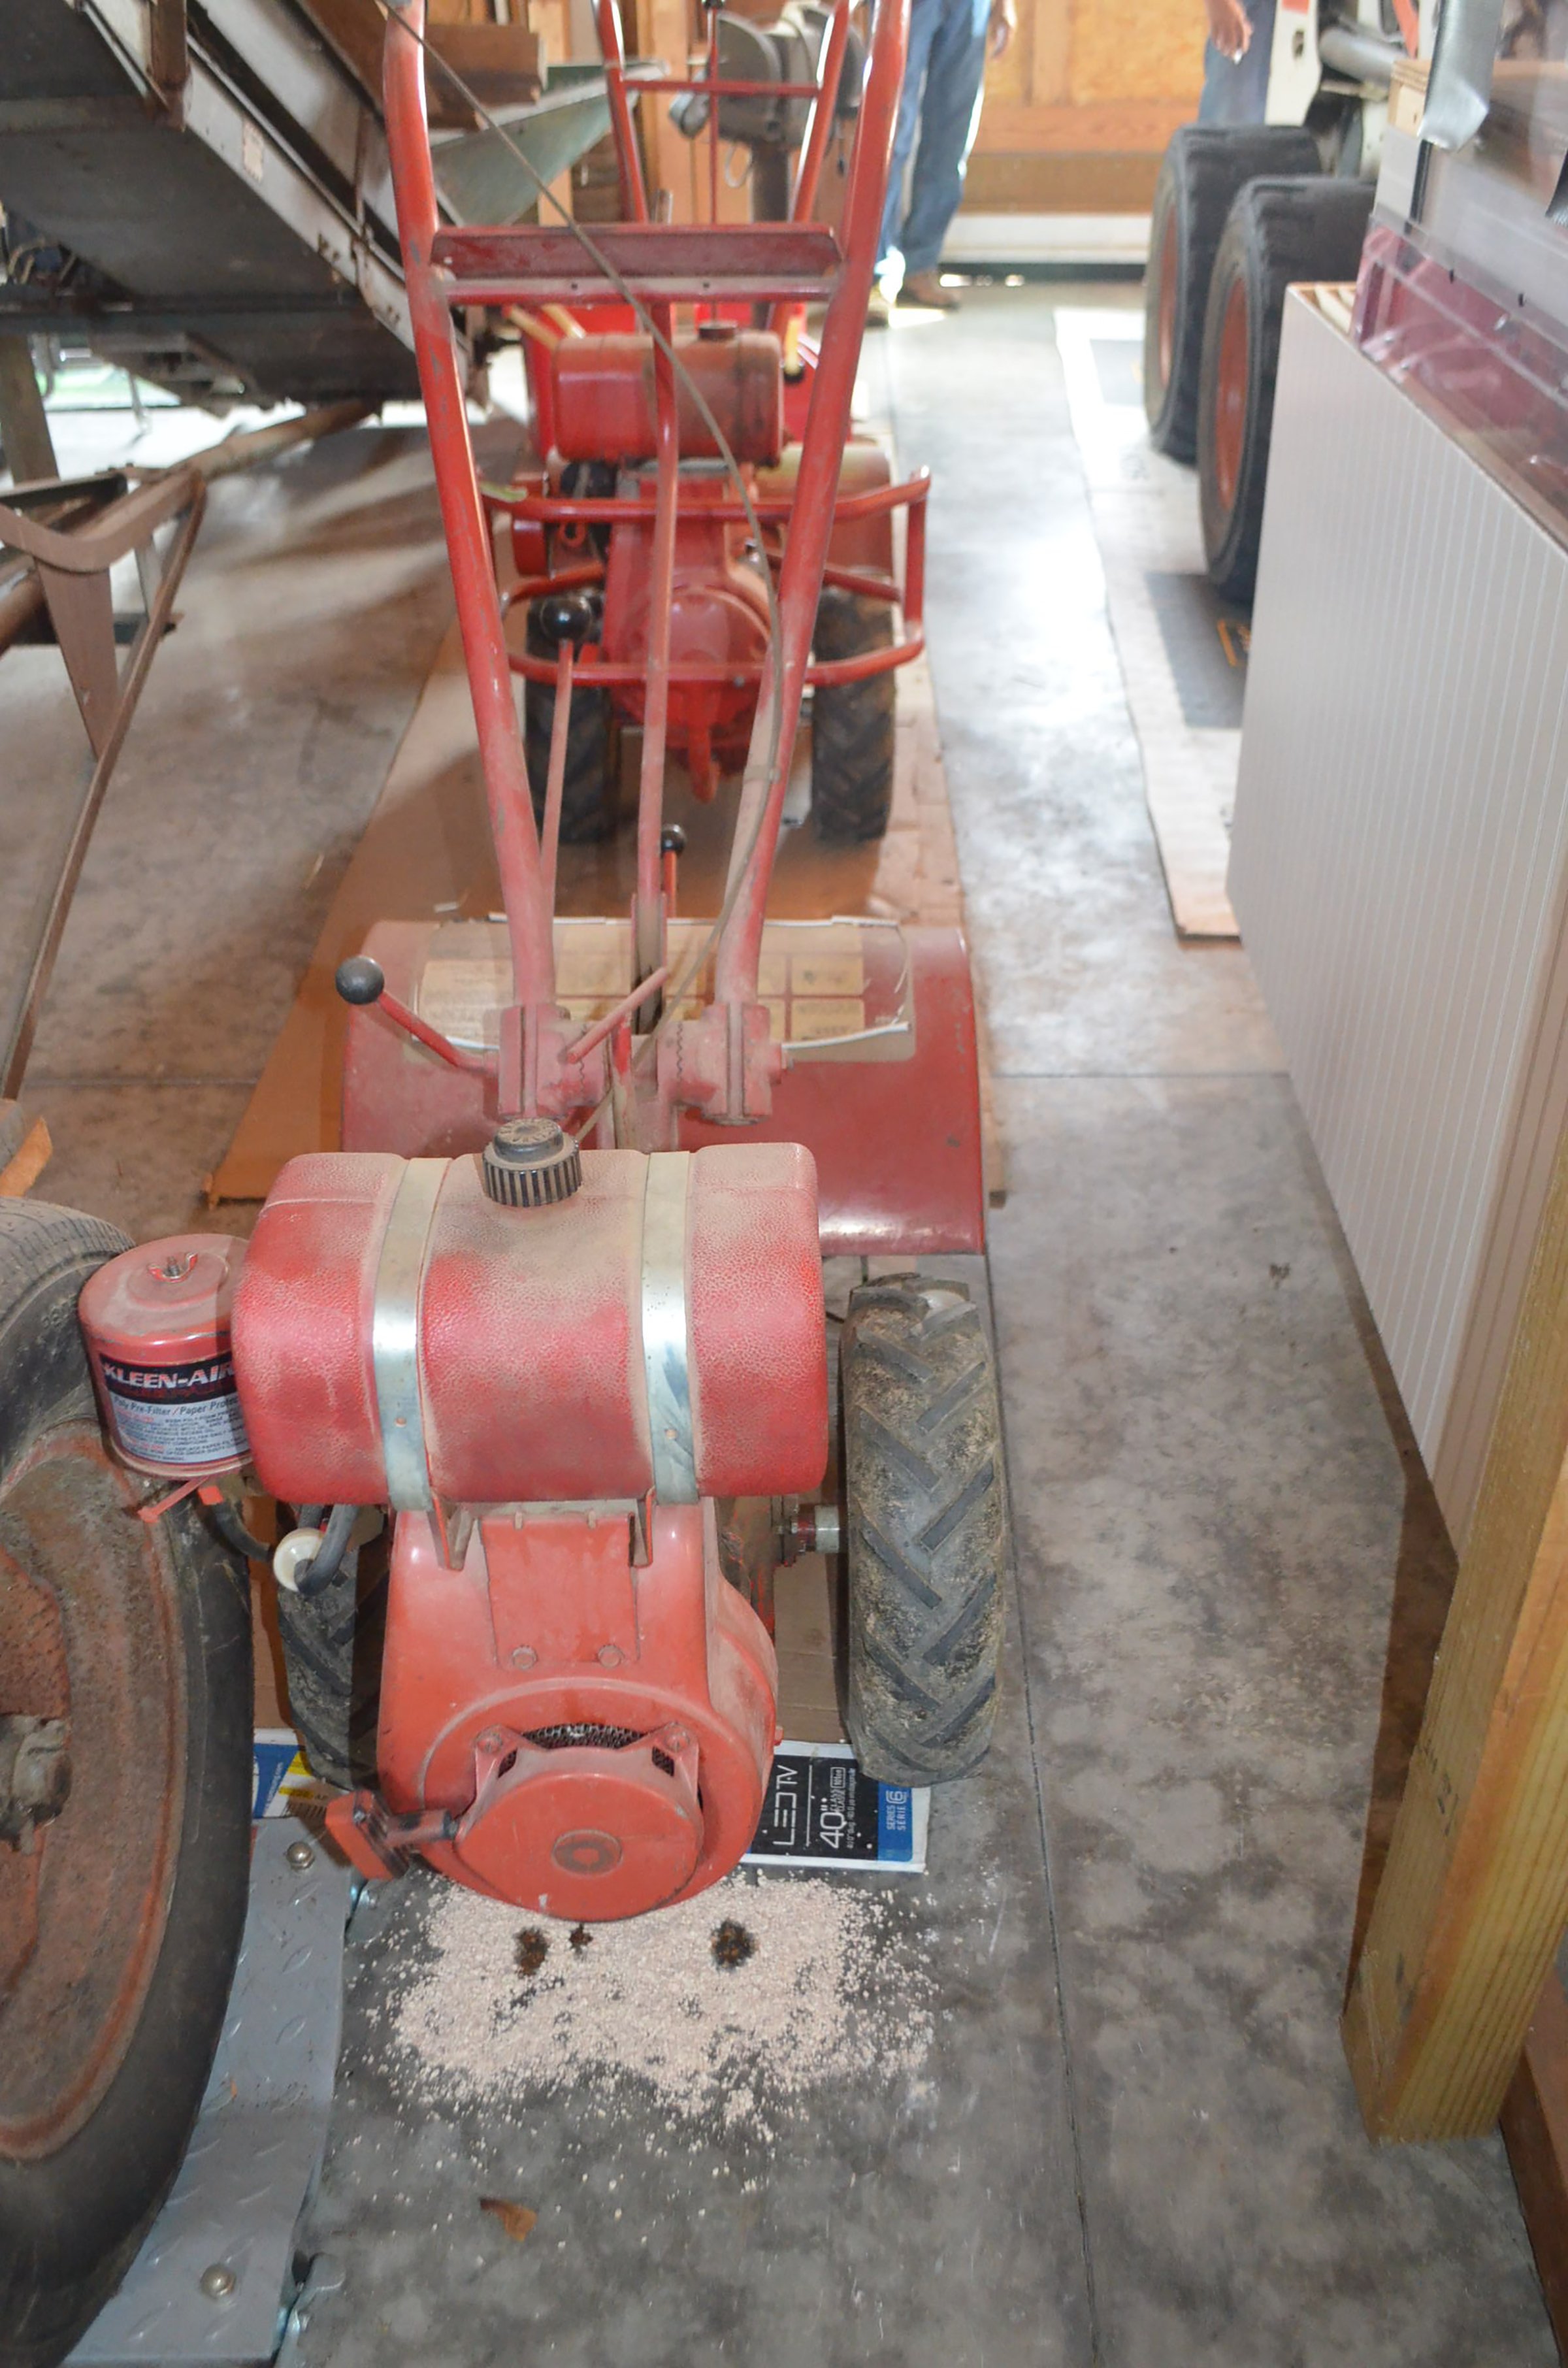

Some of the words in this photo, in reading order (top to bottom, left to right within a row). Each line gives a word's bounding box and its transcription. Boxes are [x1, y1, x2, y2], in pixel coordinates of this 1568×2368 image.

[104, 1362, 234, 1389] KLEEN-AIR
[776, 1764, 798, 1790] TV
[772, 1792, 796, 1846] LED
[886, 1804, 896, 1830] SERIES
